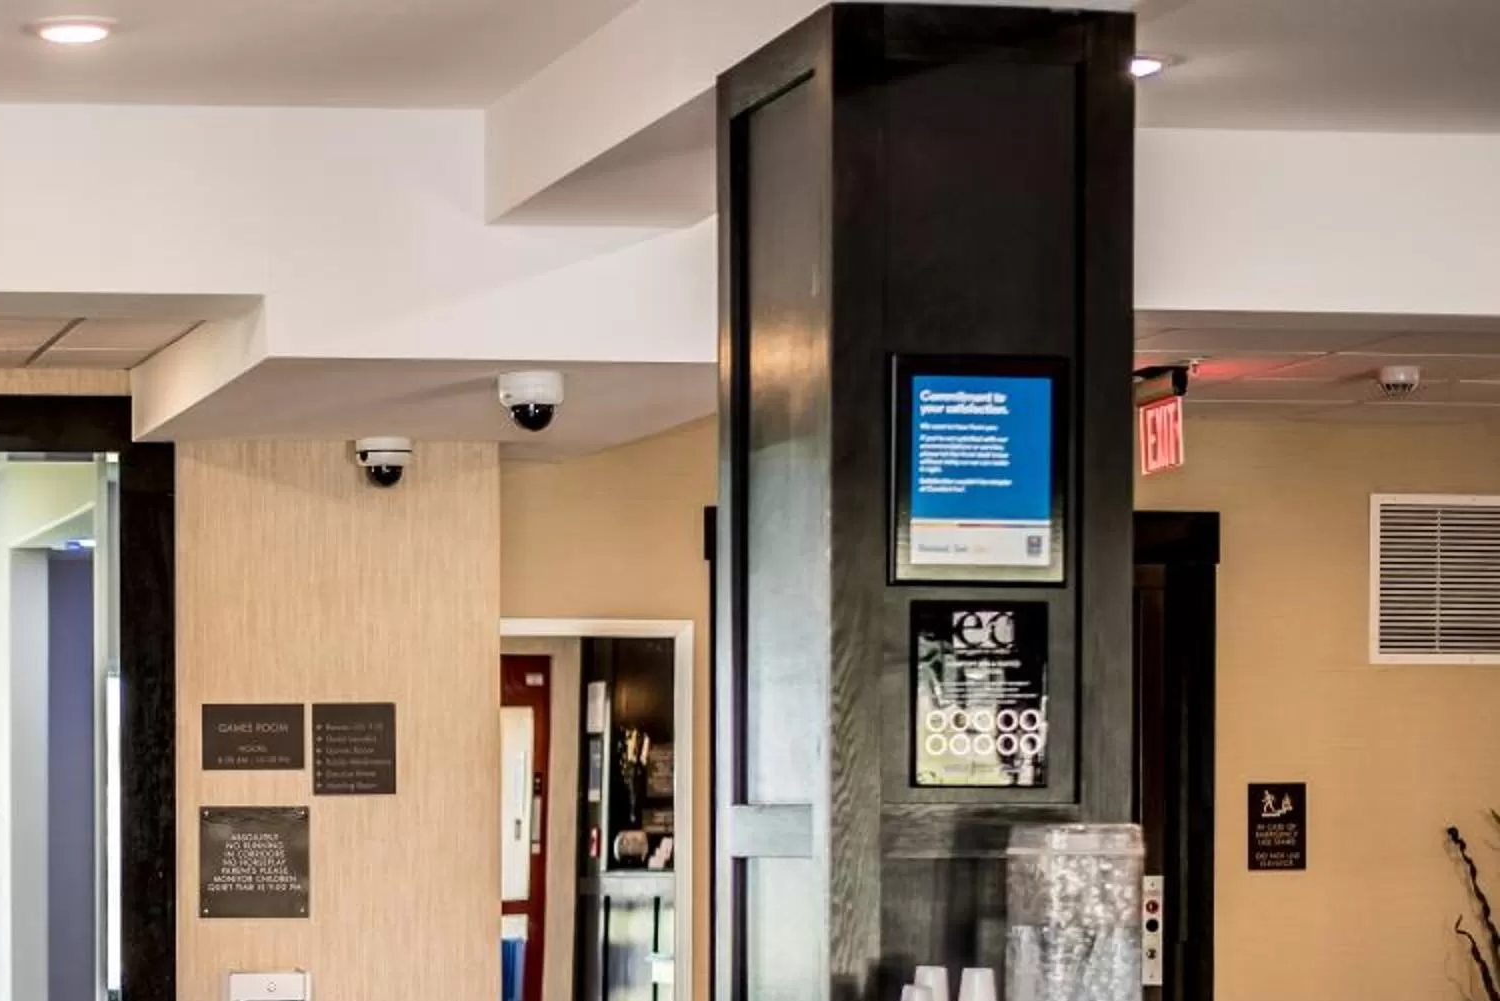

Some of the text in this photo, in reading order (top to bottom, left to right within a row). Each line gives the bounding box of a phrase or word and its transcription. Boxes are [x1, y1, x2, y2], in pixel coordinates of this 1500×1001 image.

[1146, 402, 1180, 470] EXIT
[218, 723, 289, 733] GAMES ROOM
[225, 841, 240, 849] NO
[213, 875, 253, 883] MONITOR
